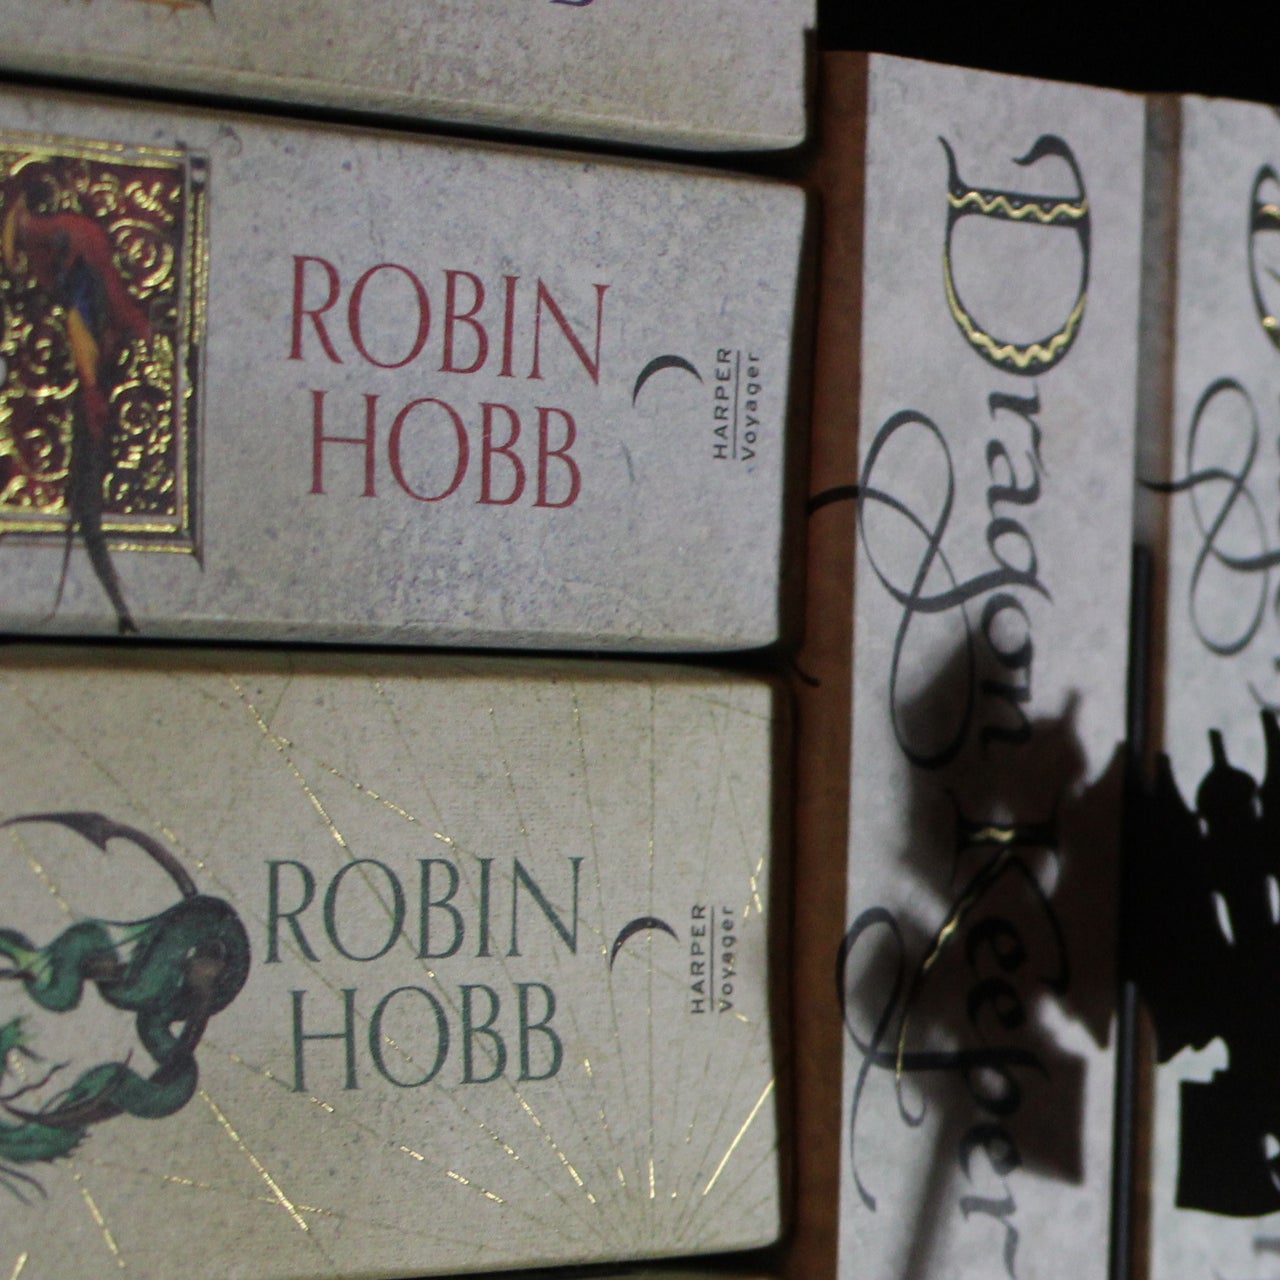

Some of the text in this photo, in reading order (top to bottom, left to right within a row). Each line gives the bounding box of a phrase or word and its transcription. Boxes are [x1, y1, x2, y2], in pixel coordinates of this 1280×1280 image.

[287, 255, 611, 385] ROBIN
[308, 390, 583, 509] HOBB
[712, 346, 732, 460] HARPER
[739, 350, 761, 463] Voyager
[858, 133, 1092, 768] Dragon
[262, 856, 585, 966] ROBIN
[690, 902, 706, 1014] HARPER
[718, 904, 737, 1015] Voyager
[290, 982, 565, 1093] HOBB
